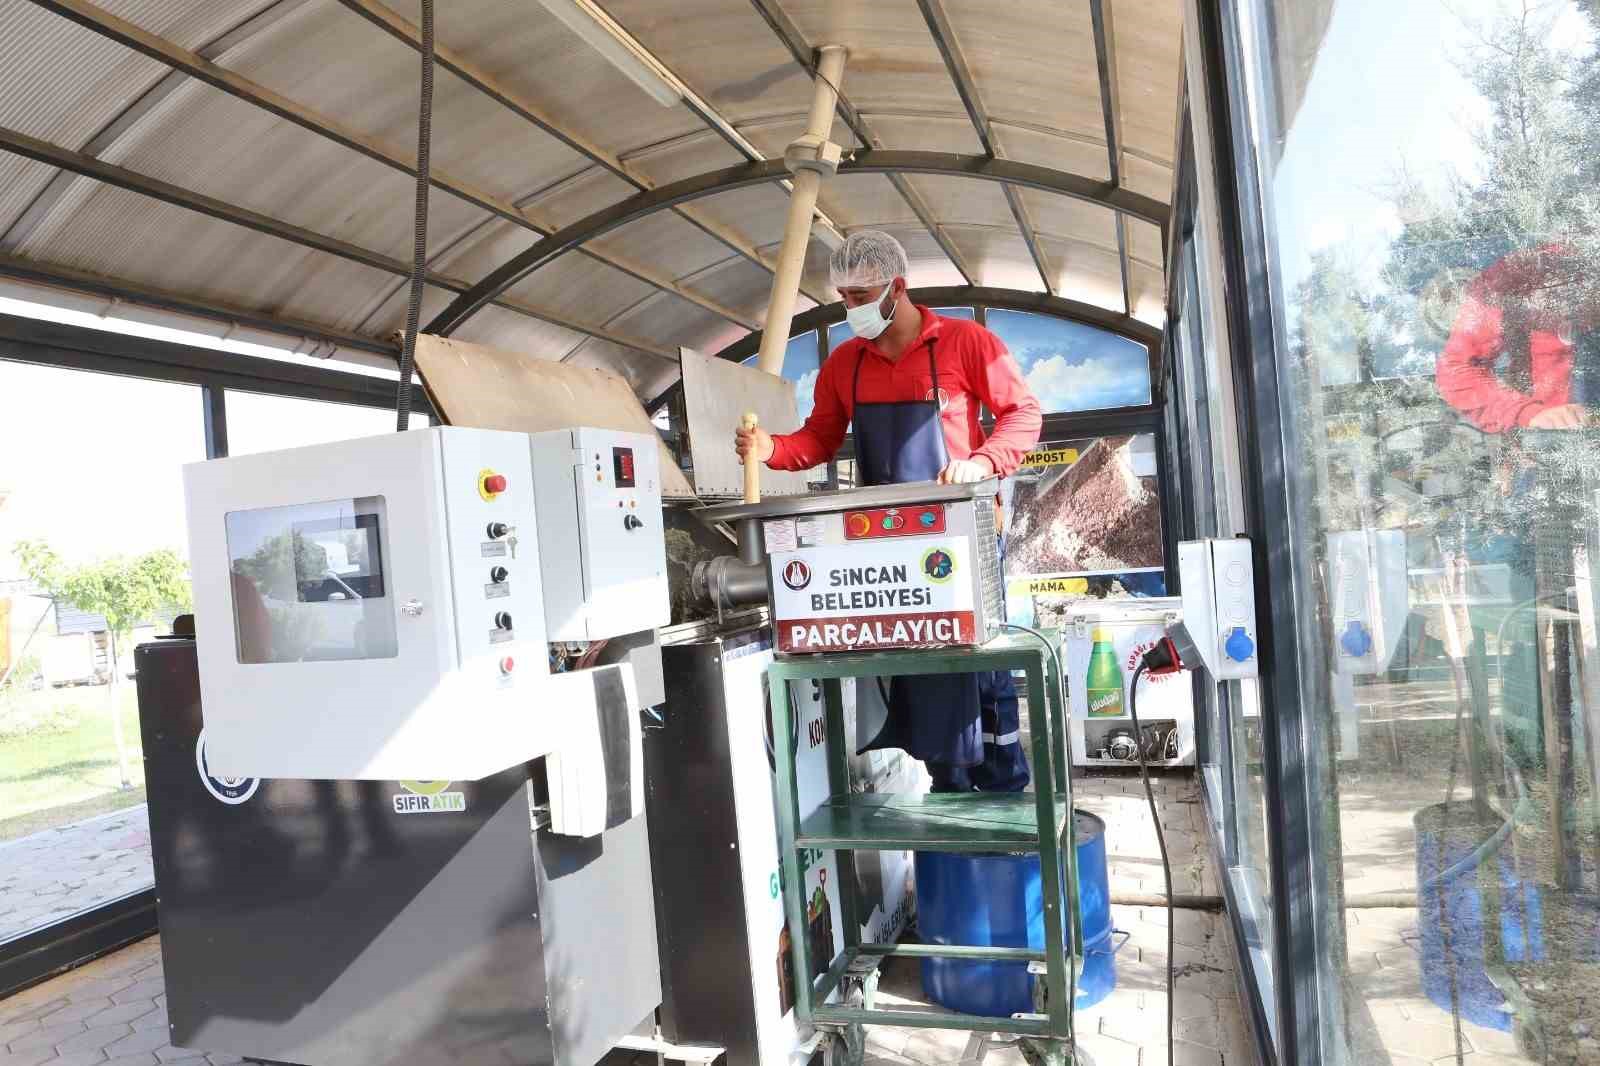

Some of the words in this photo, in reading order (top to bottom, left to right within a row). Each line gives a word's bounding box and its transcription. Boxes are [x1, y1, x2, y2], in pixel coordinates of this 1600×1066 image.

[1029, 581, 1066, 593] MAMA
[791, 617, 962, 650] PARÇALAYICI
[395, 796, 431, 810] SIFIR
[432, 794, 463, 809] ATIK
